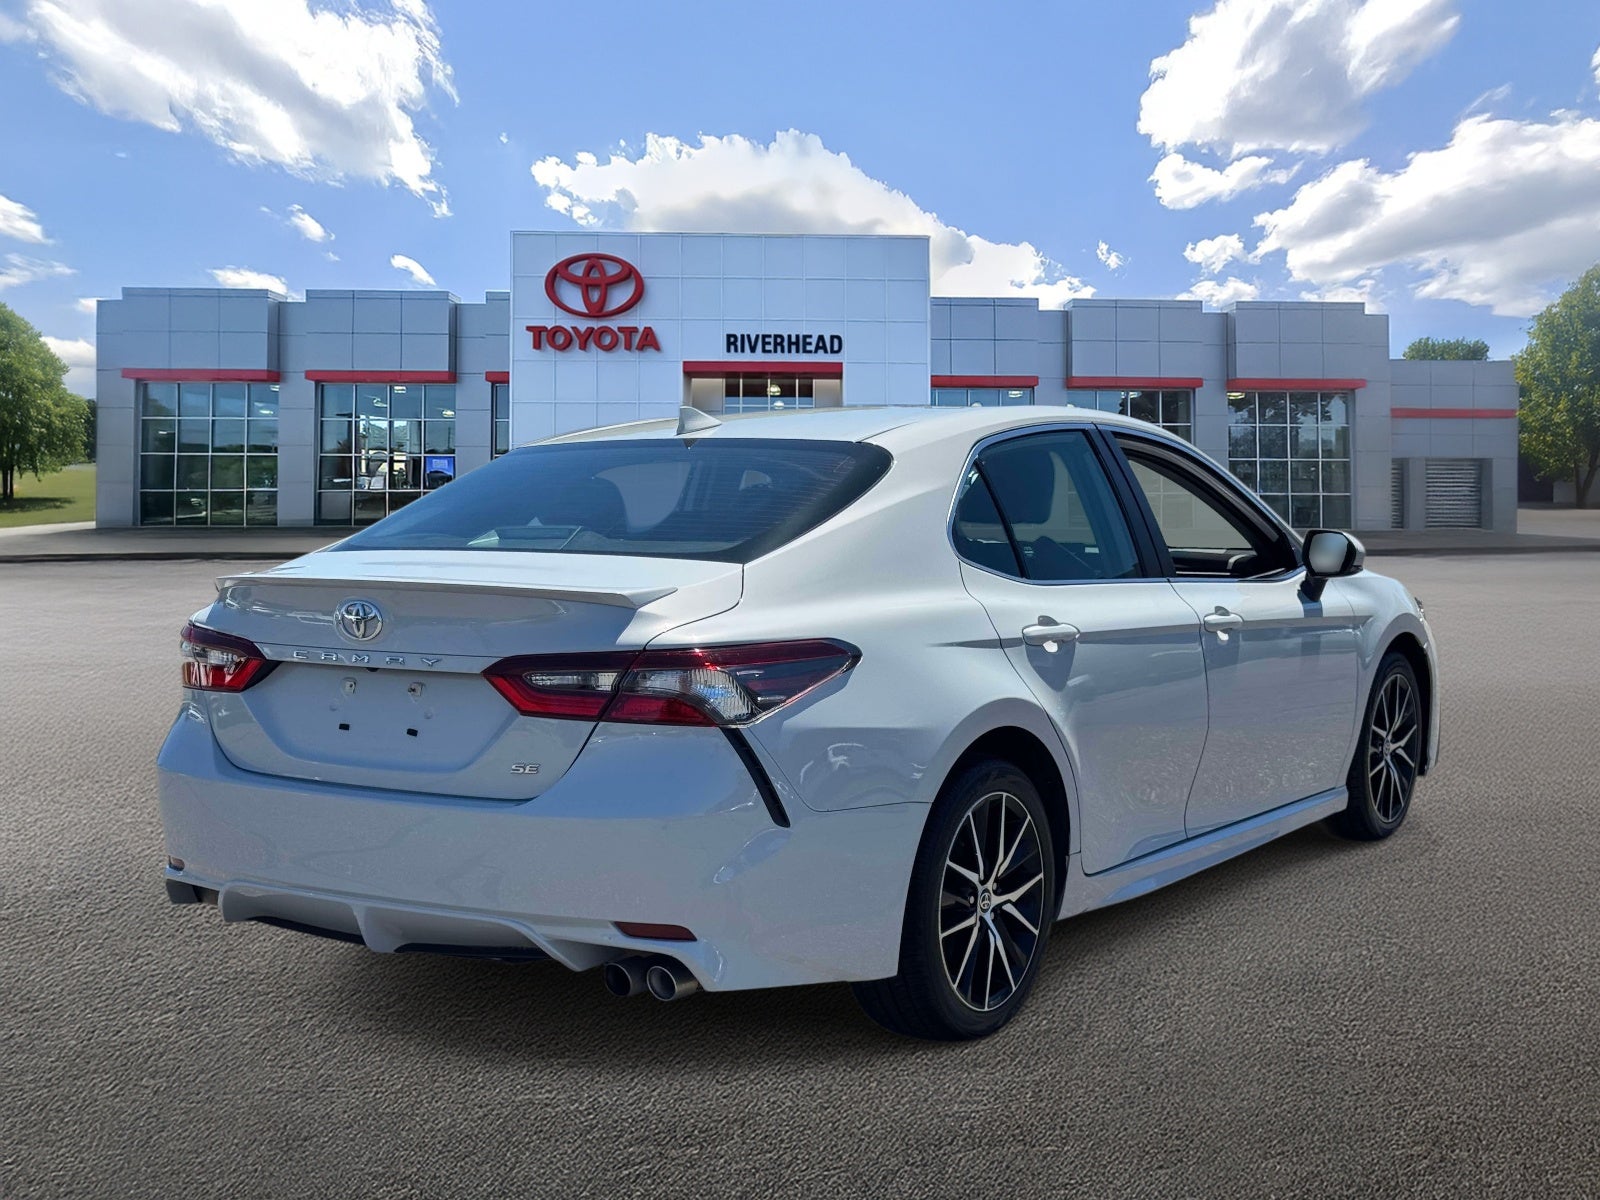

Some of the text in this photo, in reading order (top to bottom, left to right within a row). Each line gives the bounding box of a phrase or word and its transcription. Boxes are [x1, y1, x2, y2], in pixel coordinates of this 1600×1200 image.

[525, 325, 661, 352] TOYOTA
[726, 333, 843, 354] RIVERHEAD
[293, 650, 442, 667] CAMRY
[510, 763, 540, 774] SE
